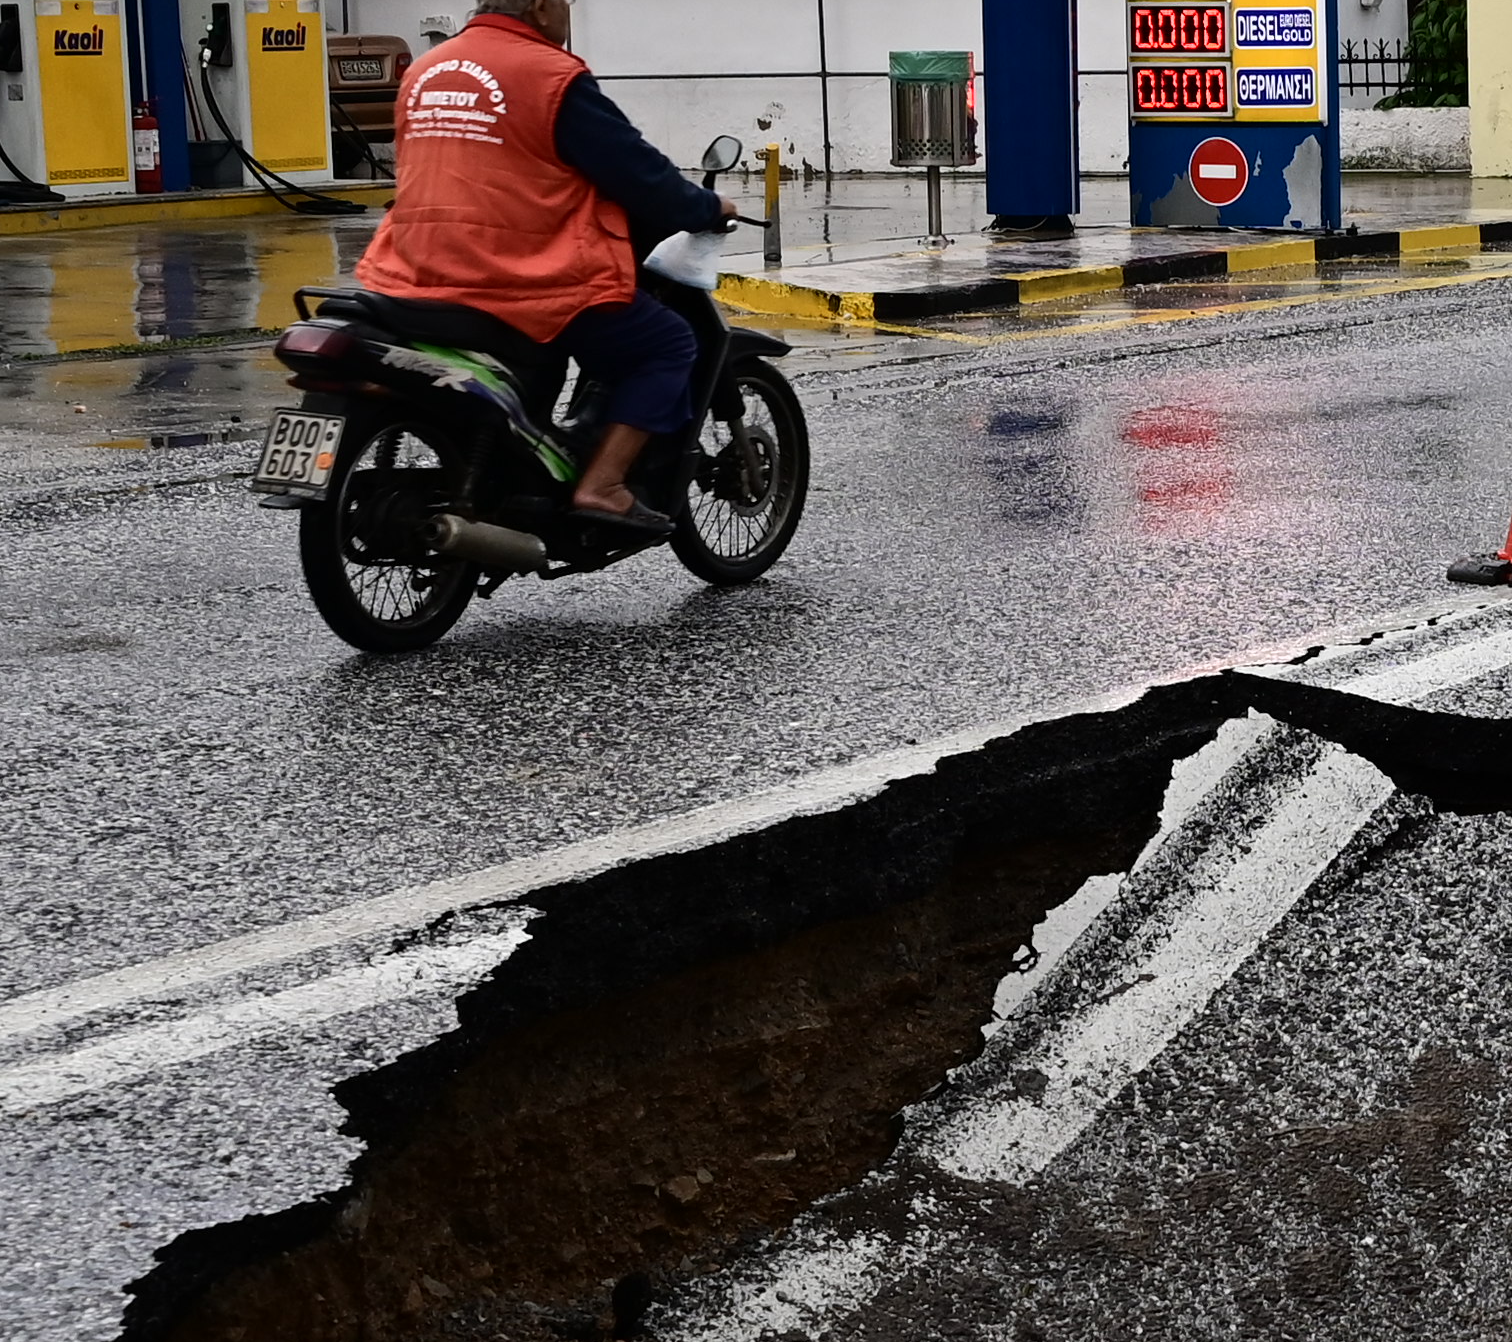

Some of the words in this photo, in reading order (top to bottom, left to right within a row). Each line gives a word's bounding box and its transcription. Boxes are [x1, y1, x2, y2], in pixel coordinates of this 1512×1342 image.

[54, 25, 104, 51] Kaoil
[262, 22, 306, 47] Kaoil
[1135, 8, 1223, 50] 0.000
[1238, 15, 1282, 41] DIESEL
[1282, 29, 1311, 42] GOLD
[1137, 69, 1224, 109] 0.000
[1239, 74, 1312, 102] ΘΕΡΜΑΝΣΗ
[266, 448, 312, 480] 603
